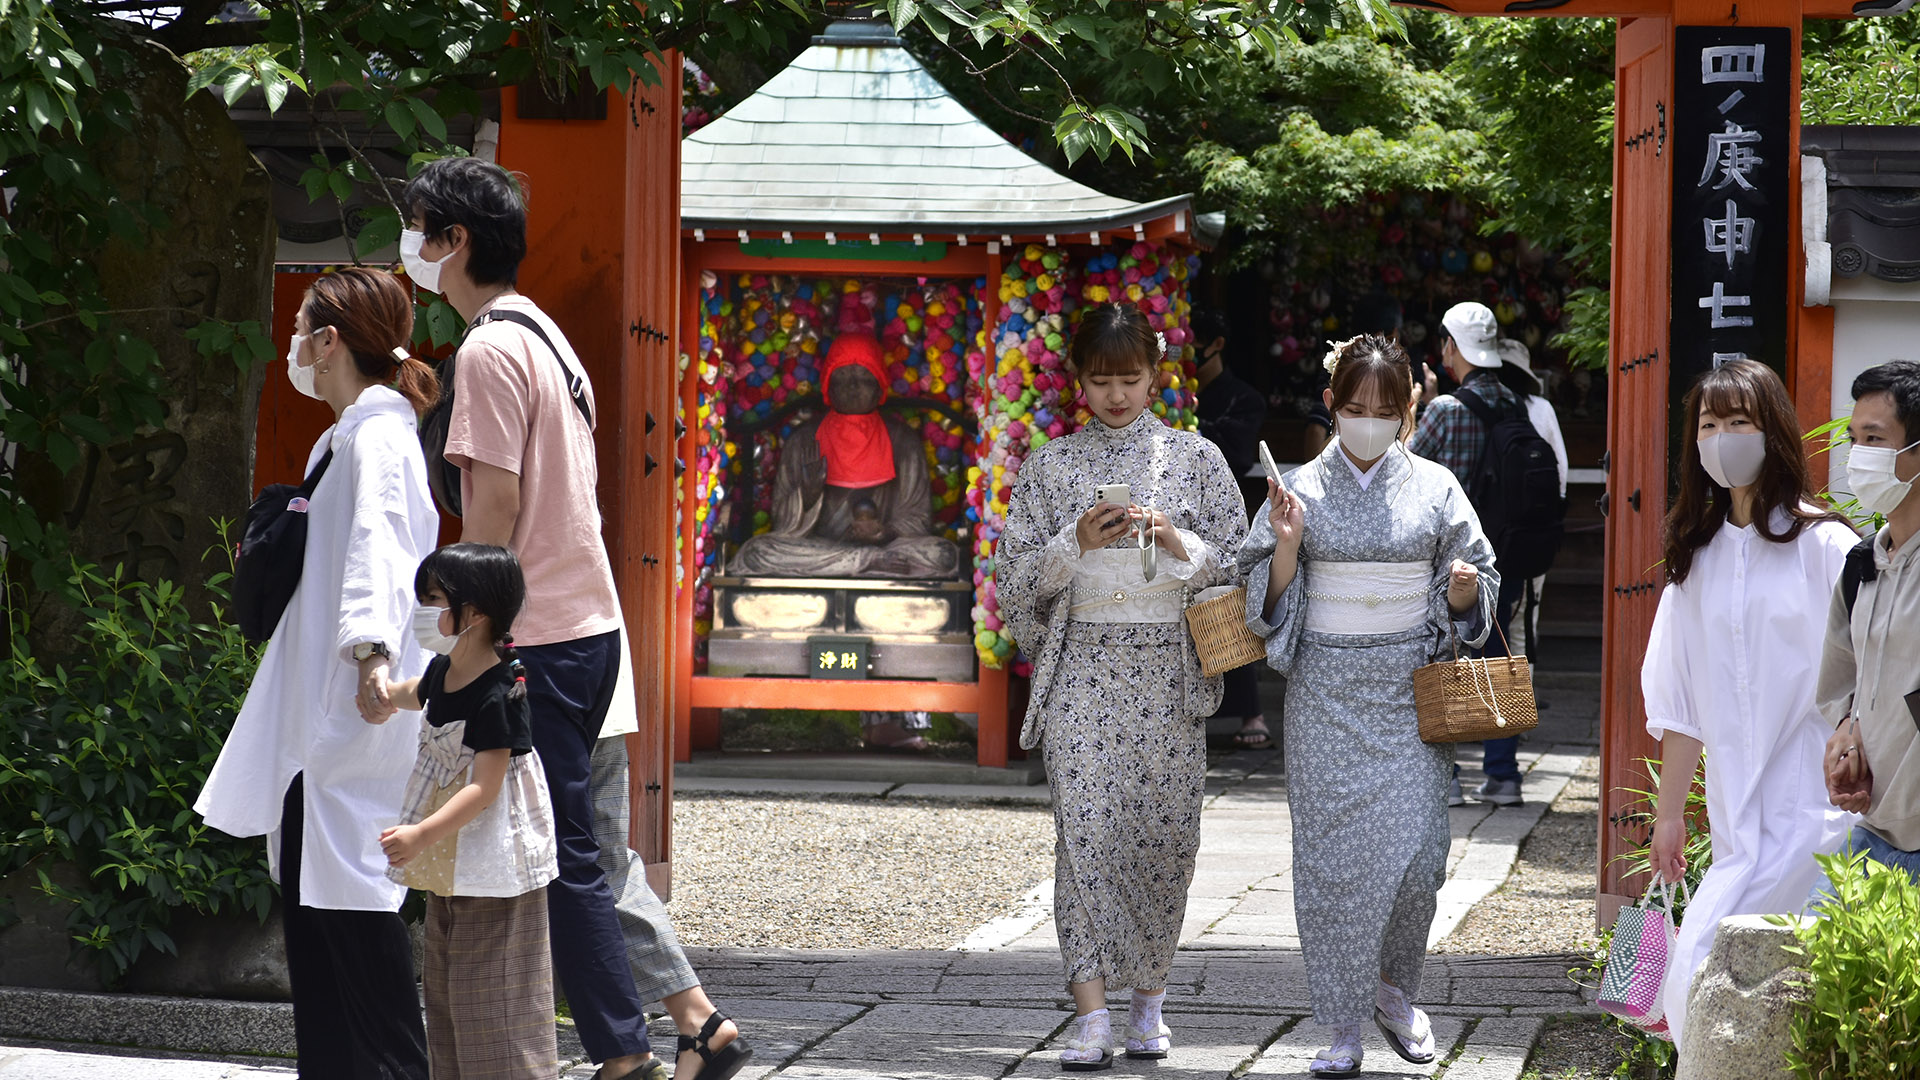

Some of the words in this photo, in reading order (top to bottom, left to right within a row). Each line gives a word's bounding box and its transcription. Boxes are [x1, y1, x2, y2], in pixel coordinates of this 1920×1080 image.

[1698, 44, 1765, 370] 四ノ庚申七
